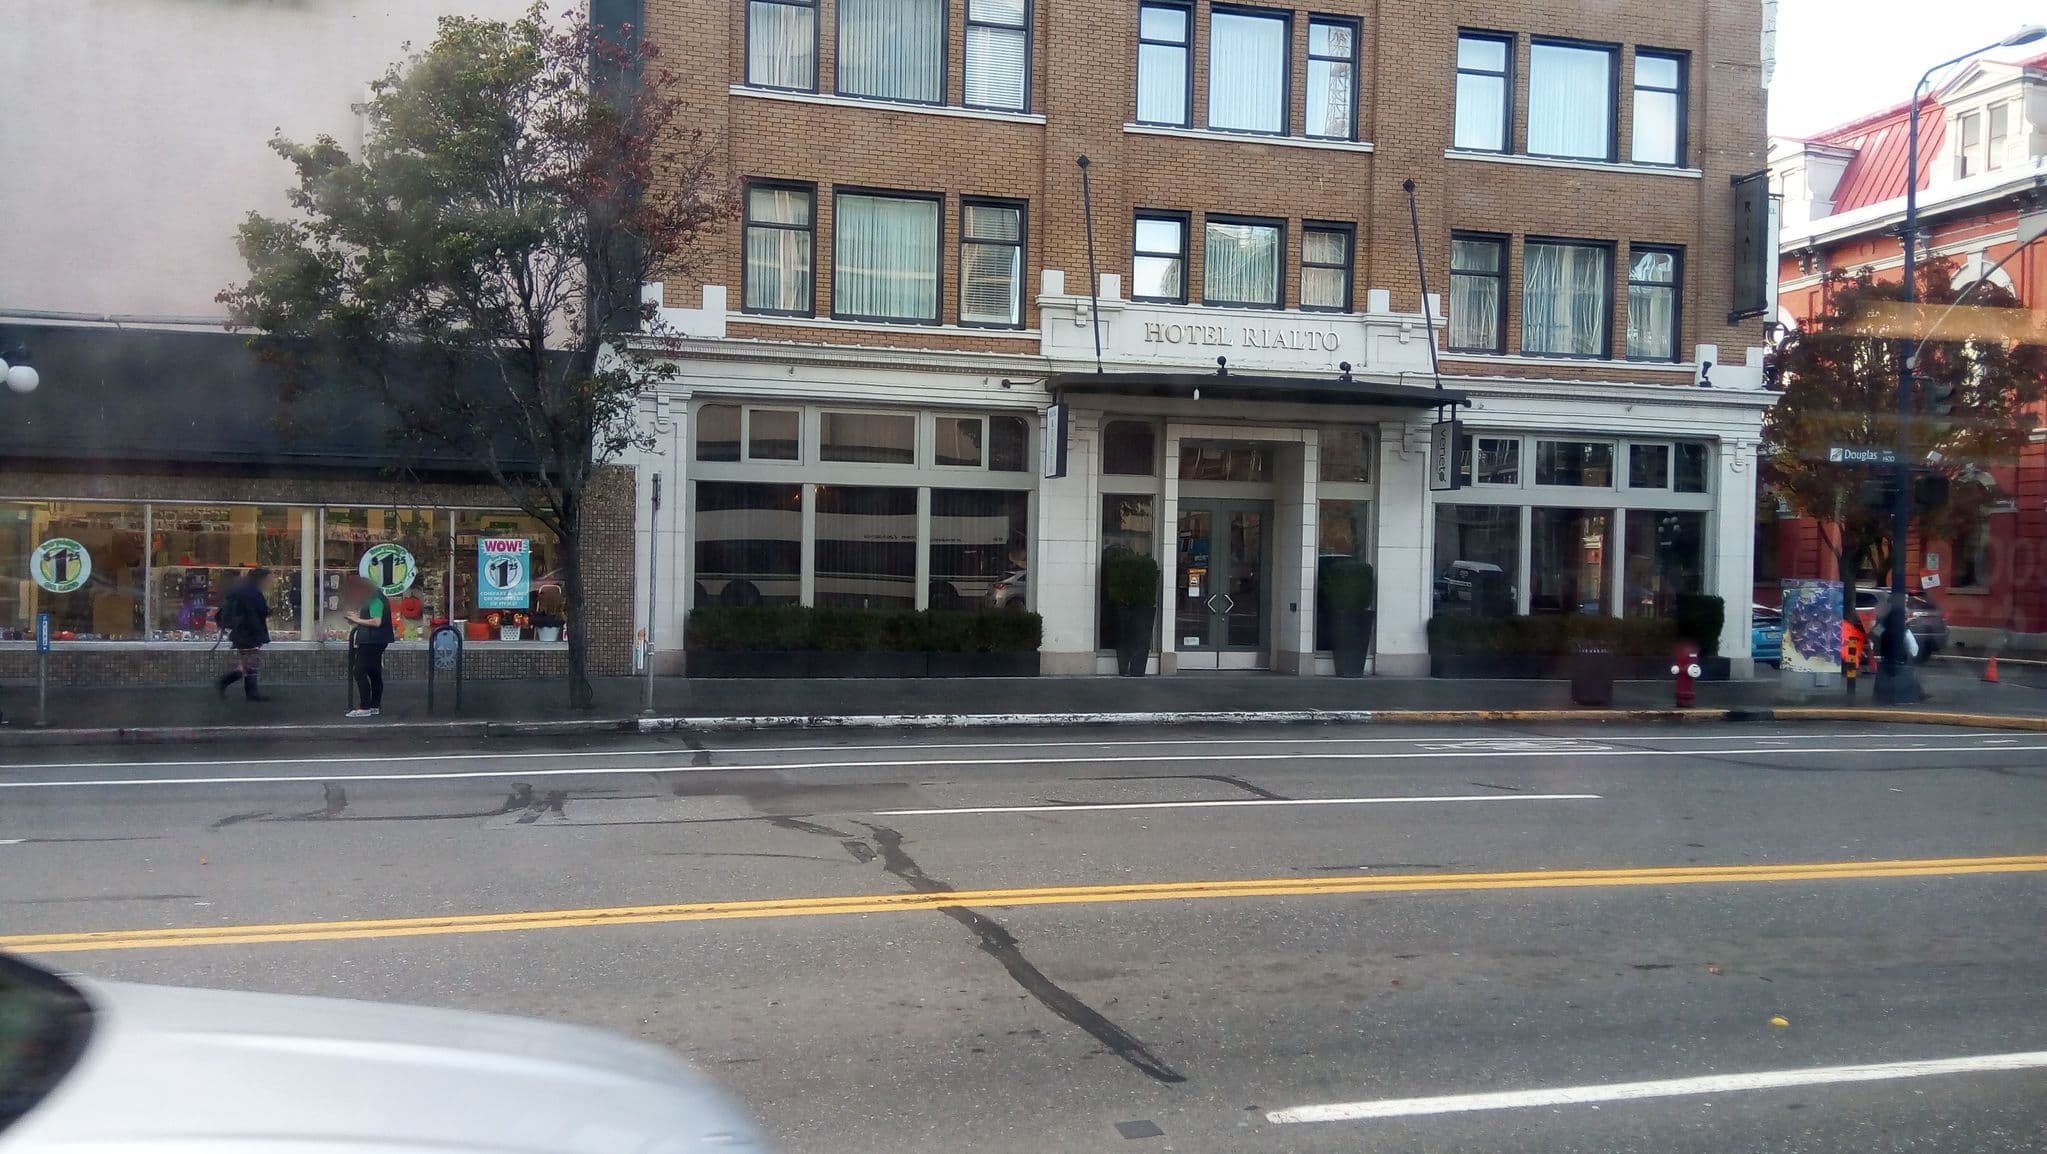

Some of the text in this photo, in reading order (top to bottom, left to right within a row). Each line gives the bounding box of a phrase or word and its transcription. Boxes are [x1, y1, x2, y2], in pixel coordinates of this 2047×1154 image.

[1144, 322, 1340, 351] HOTEL RIALTO
[1844, 449, 1877, 461] Douglas
[485, 540, 522, 552] WOW!
